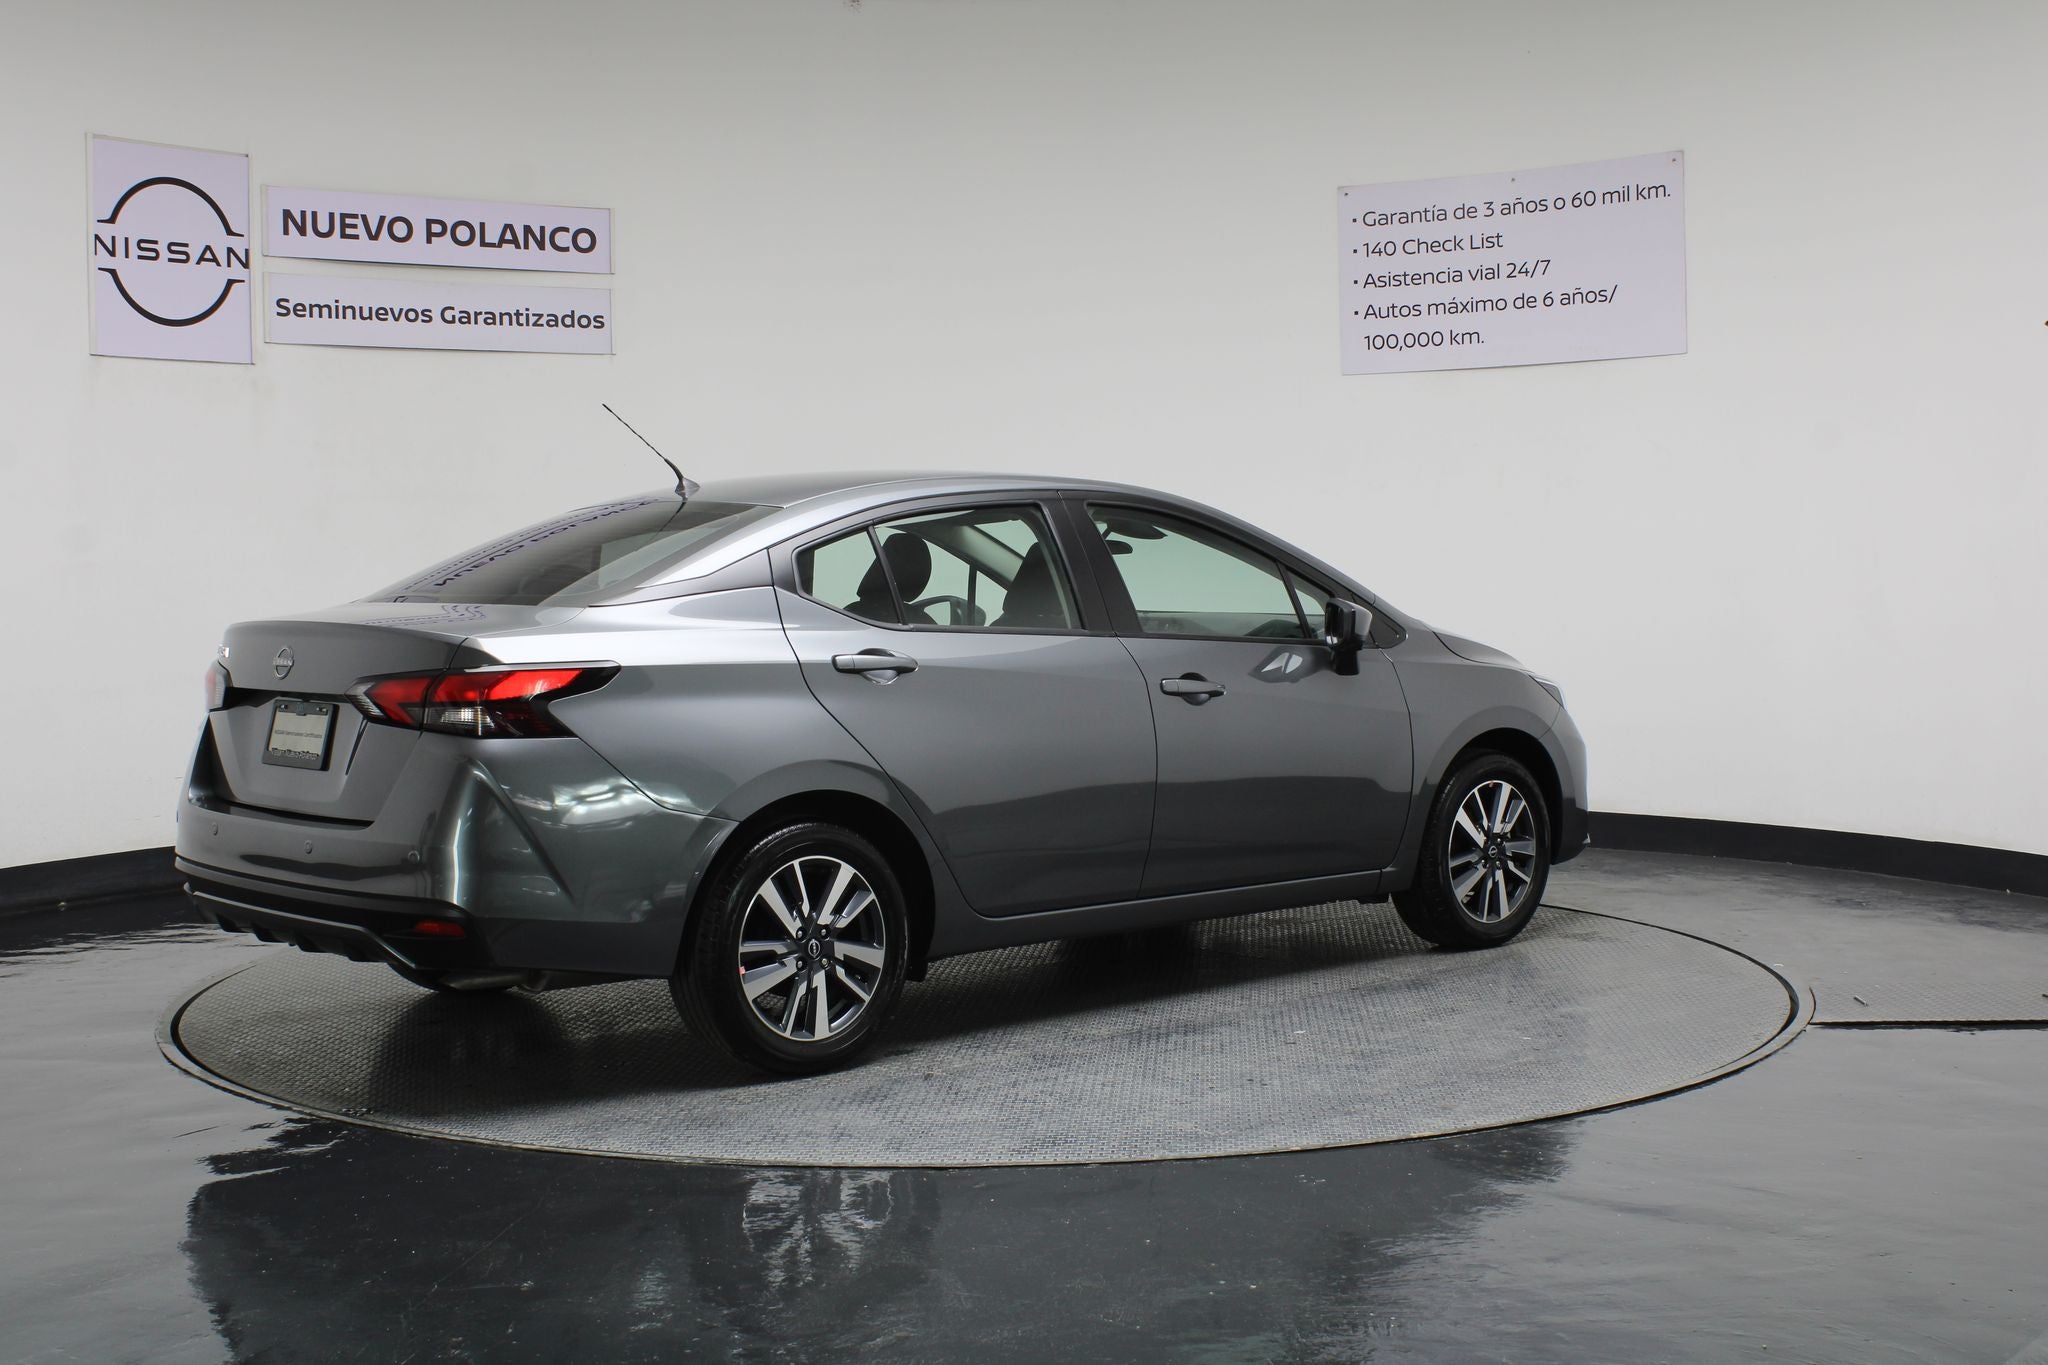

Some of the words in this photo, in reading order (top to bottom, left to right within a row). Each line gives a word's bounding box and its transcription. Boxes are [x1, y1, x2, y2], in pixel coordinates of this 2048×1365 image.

[1362, 204, 1448, 227] Garantía
[1453, 202, 1478, 220] de
[1483, 201, 1495, 218] 3
[1500, 197, 1549, 216] años
[1553, 196, 1566, 211] o
[1571, 190, 1597, 209] 60
[1602, 184, 1631, 205] mil
[1635, 183, 1672, 201] km.
[282, 208, 414, 244] NUEVO
[425, 217, 597, 254] POLANCO
[1362, 240, 1397, 258] 140
[1402, 234, 1465, 255] Check
[1469, 232, 1504, 250] List
[94, 233, 251, 270] NISSAN
[1362, 268, 1463, 289] Asistencia
[1467, 263, 1501, 282] vial
[1506, 259, 1551, 279] 24/7
[275, 297, 434, 324] Seminuevos
[439, 305, 606, 330] Garantizados
[1363, 303, 1422, 320] Autos
[1427, 296, 1508, 316] máximo
[1512, 292, 1538, 310] de
[1542, 291, 1555, 308] 6
[1559, 284, 1618, 306] años/
[1363, 330, 1444, 352] 100,000
[1449, 329, 1485, 346] km.
